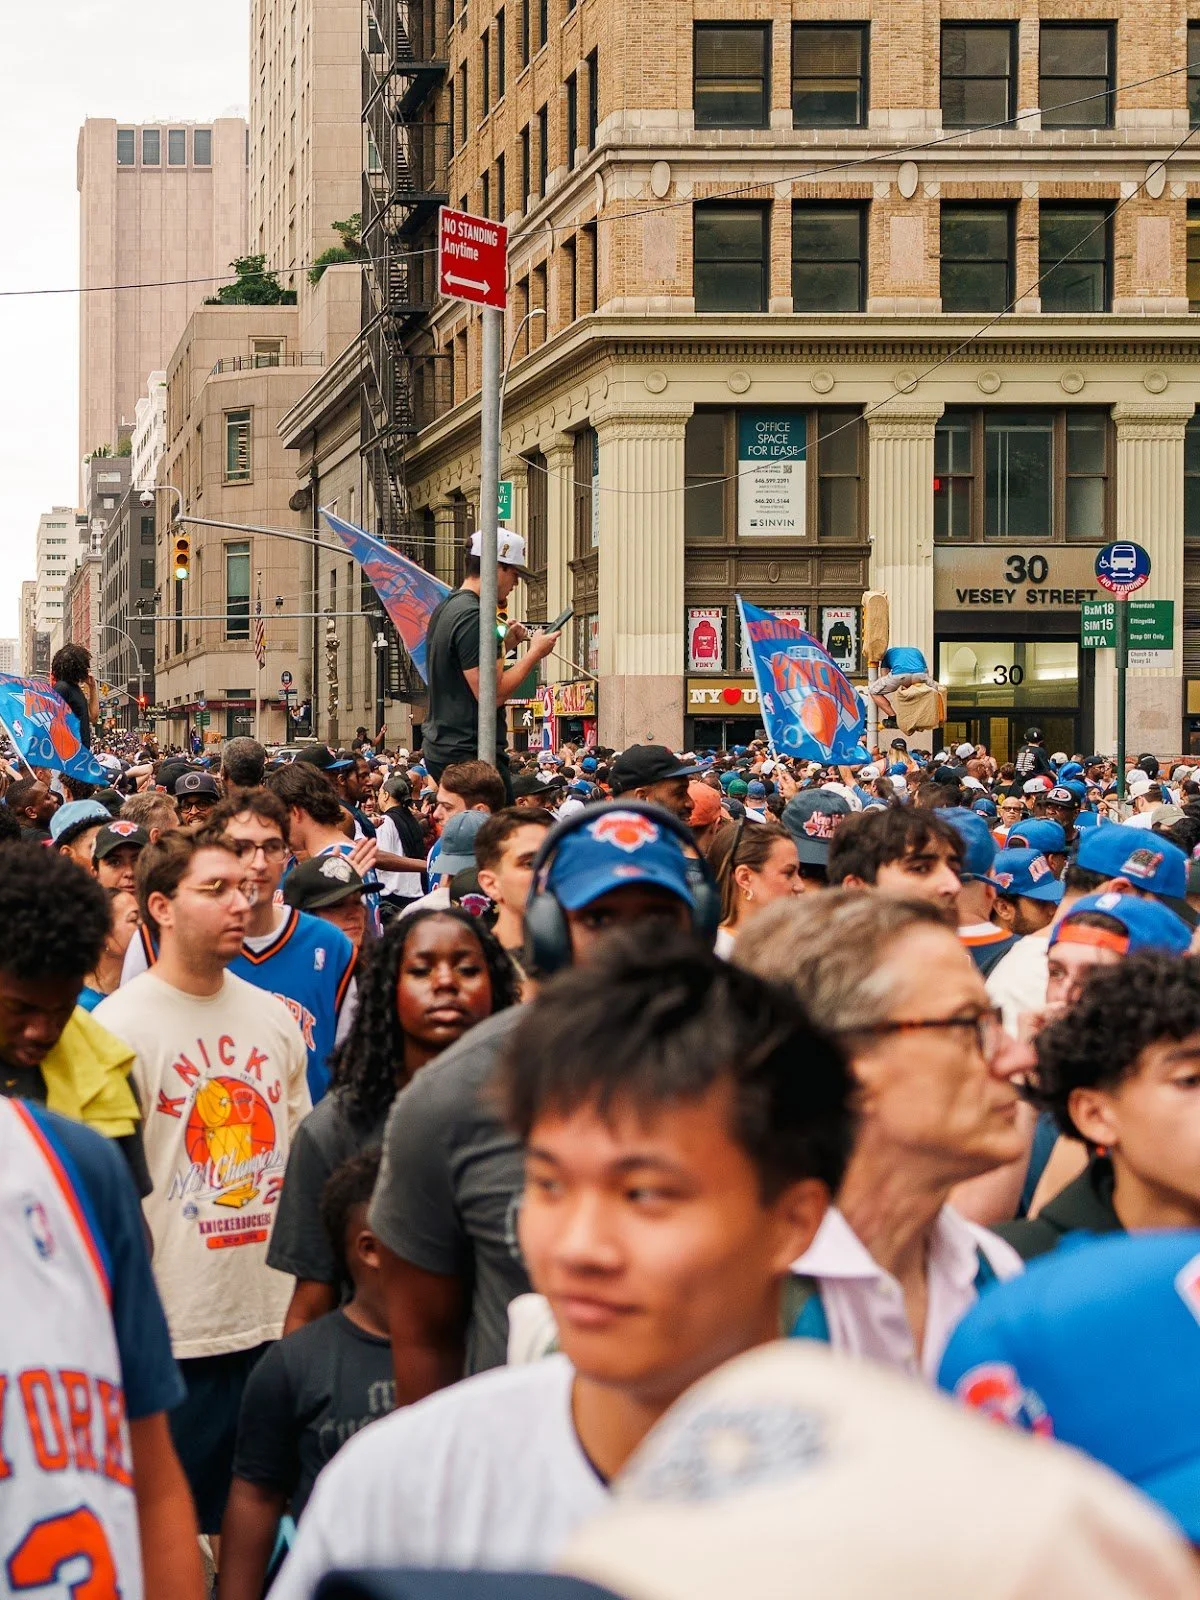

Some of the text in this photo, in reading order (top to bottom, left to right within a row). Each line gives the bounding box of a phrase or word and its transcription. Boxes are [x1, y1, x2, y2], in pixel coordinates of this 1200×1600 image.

[443, 218, 498, 247] NO STANDING
[444, 238, 479, 261] Anytime
[755, 422, 790, 432] OFFICE
[757, 434, 788, 444] SPACE
[748, 445, 798, 456] FOR LEASE
[759, 519, 794, 527] SINVIN
[1005, 554, 1048, 584] 30
[1100, 577, 1145, 592] NO STANDING
[956, 589, 1098, 604] VESEY STREET
[1084, 603, 1114, 615] BxM18
[1084, 618, 1113, 630] SIM15
[1084, 636, 1107, 646] MTA
[993, 665, 1024, 686] 30
[689, 689, 722, 704] NY
[27, 736, 107, 776] 20 26
[157, 1035, 282, 1119] KNICKS
[198, 1213, 271, 1234] KNICKERBOCKERS
